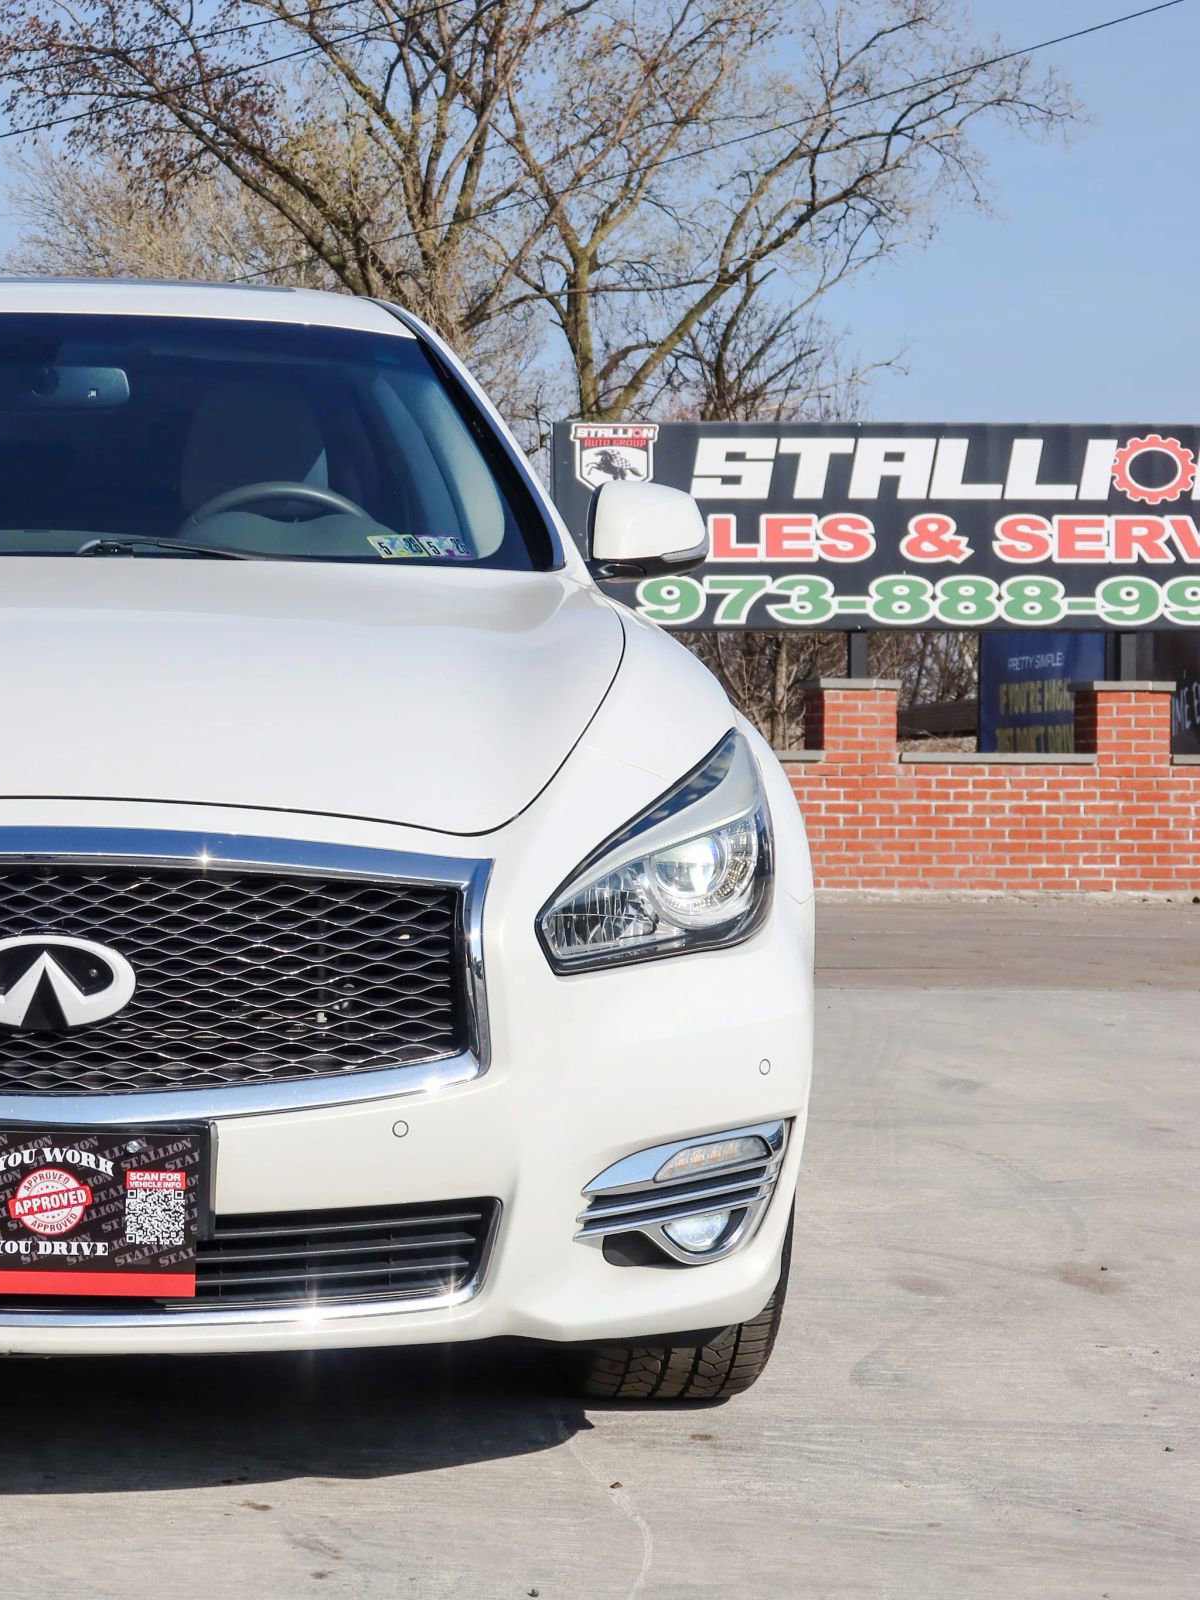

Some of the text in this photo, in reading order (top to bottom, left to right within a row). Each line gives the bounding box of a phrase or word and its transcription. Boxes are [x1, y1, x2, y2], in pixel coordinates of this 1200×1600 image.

[576, 428, 655, 438] STALLION
[584, 439, 647, 447] AUTO GROUP
[690, 434, 1200, 504] STALLIO
[705, 513, 875, 563] LES
[899, 513, 975, 564] &
[42, 1147, 114, 1177] WORK
[23, 1171, 70, 1191] APPROVED
[130, 1172, 158, 1181] SCAN
[160, 1173, 181, 1181] FOR
[15, 1189, 87, 1216] APPROVED
[30, 1213, 78, 1231] APPROVED
[37, 1241, 108, 1256] DRIVE
